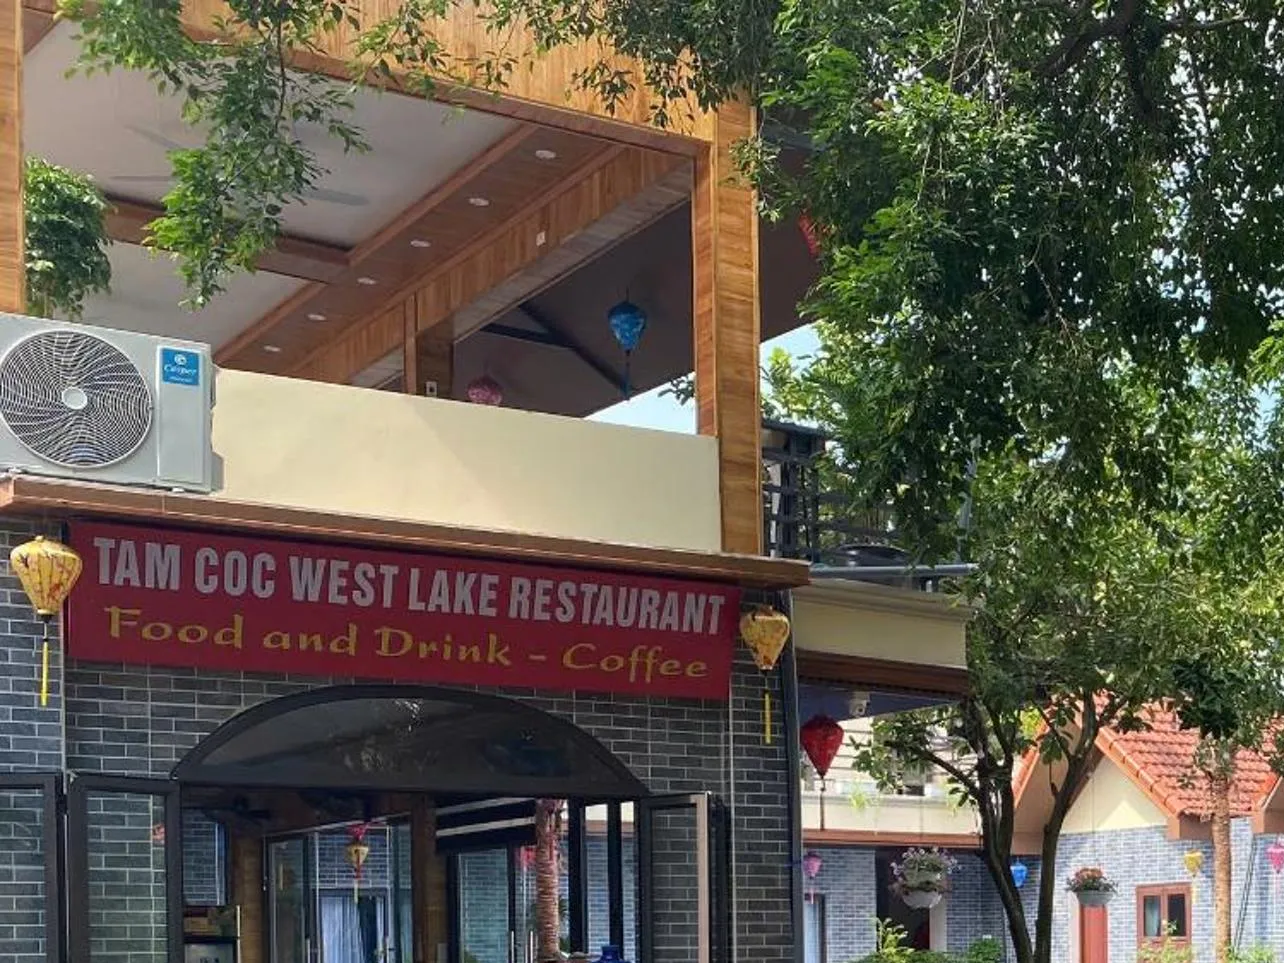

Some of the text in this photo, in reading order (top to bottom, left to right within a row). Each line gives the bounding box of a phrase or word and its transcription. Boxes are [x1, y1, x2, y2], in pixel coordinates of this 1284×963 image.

[94, 537, 725, 635] TAM COC WEST LAKE RESTAURANT
[104, 605, 244, 650] Food
[263, 623, 358, 656] and
[374, 627, 512, 667] Drink
[562, 643, 709, 683] Coffee
